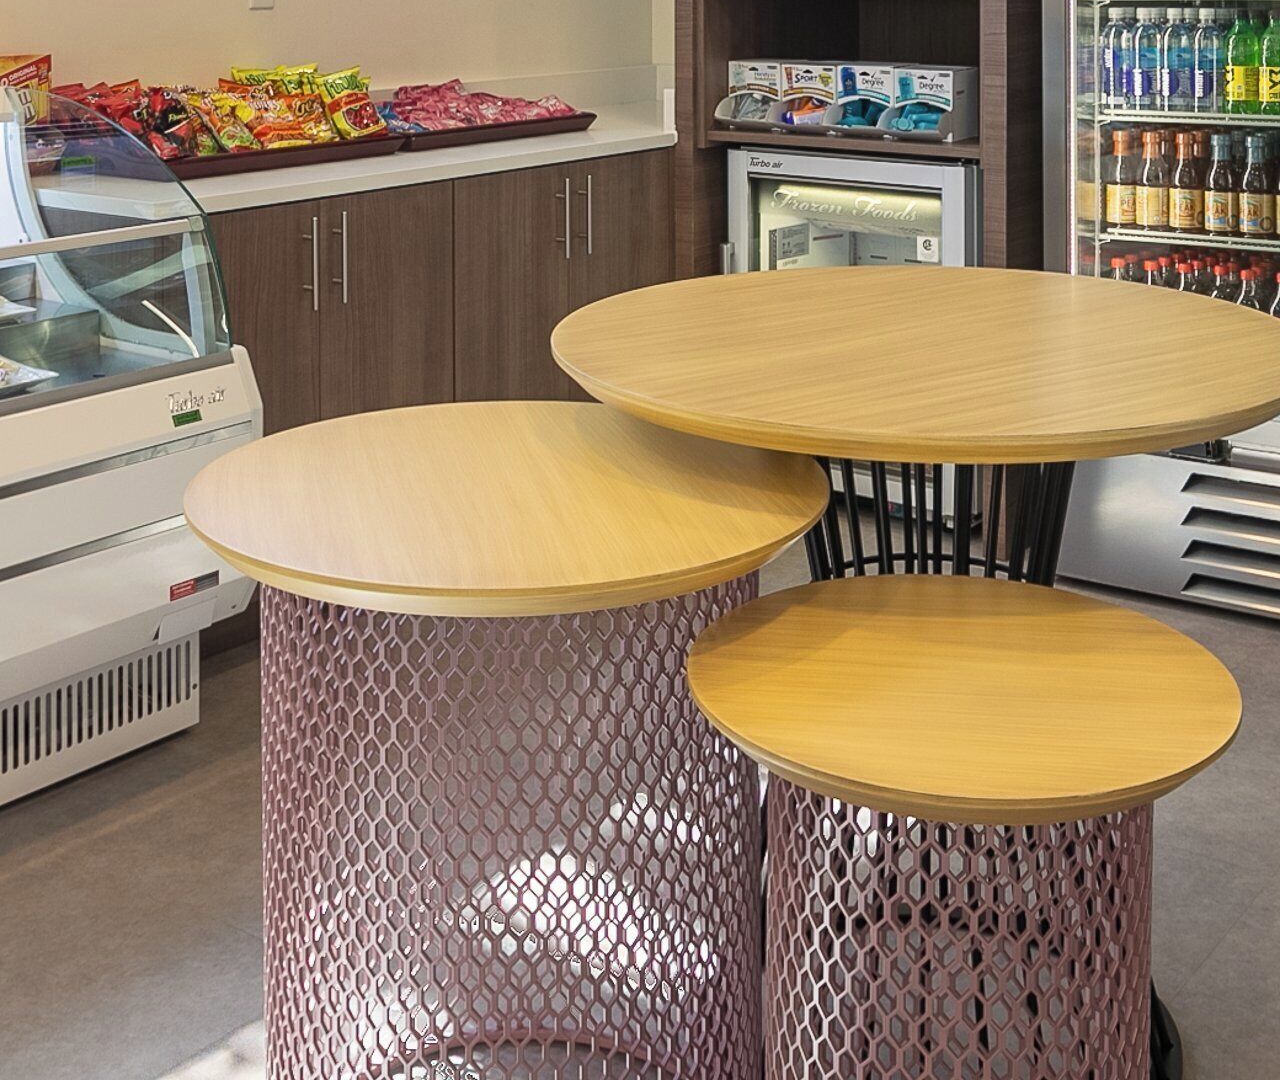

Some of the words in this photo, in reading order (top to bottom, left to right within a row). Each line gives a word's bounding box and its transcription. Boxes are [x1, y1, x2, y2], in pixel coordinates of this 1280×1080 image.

[862, 78, 884, 87] Degree
[920, 82, 945, 91] Degree
[749, 157, 771, 168] Turbo
[772, 161, 783, 169] air
[771, 188, 844, 215] Frozen
[852, 196, 918, 222] Foods
